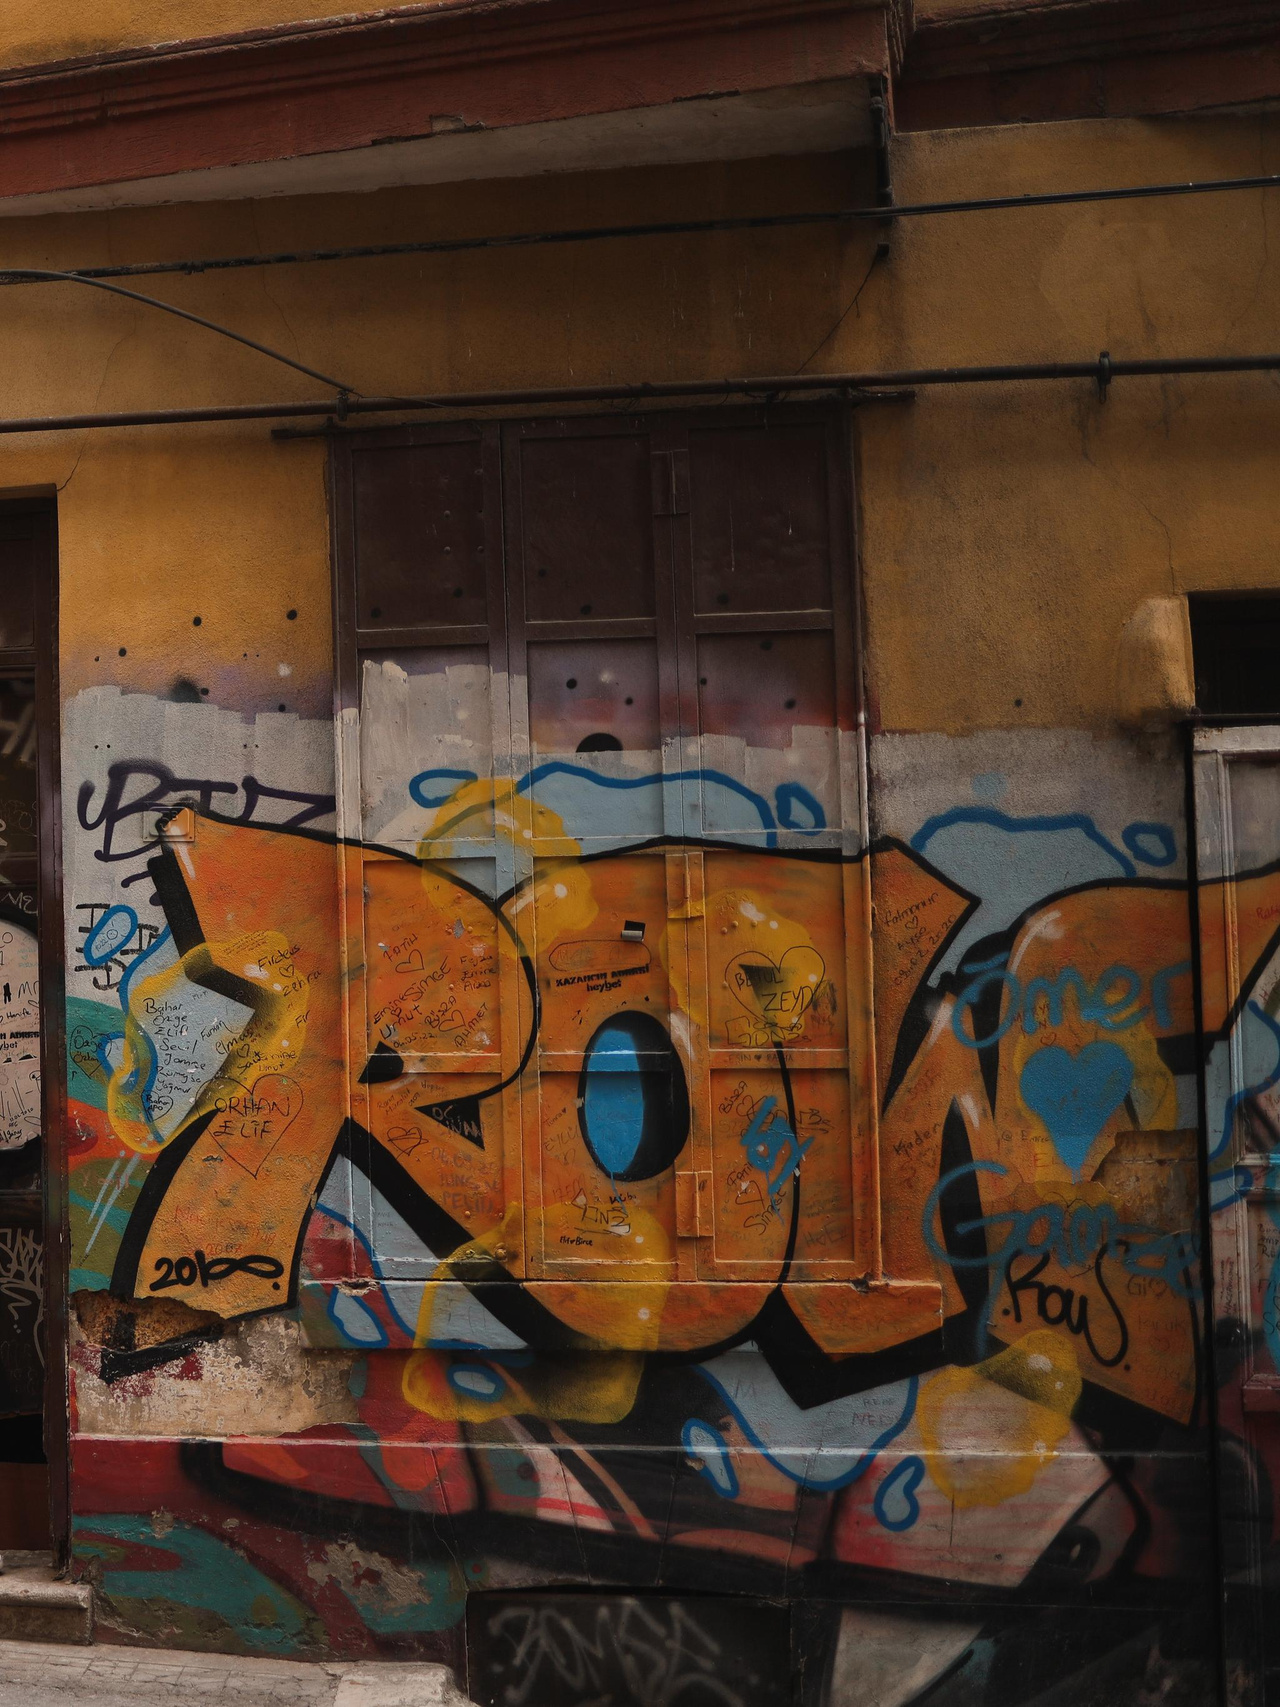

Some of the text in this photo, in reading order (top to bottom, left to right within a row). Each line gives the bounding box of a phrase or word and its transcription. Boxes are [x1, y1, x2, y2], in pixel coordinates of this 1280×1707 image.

[143, 998, 184, 1014] Bahar
[951, 950, 1192, 1049] Ömer
[214, 1096, 290, 1118] ORHAN
